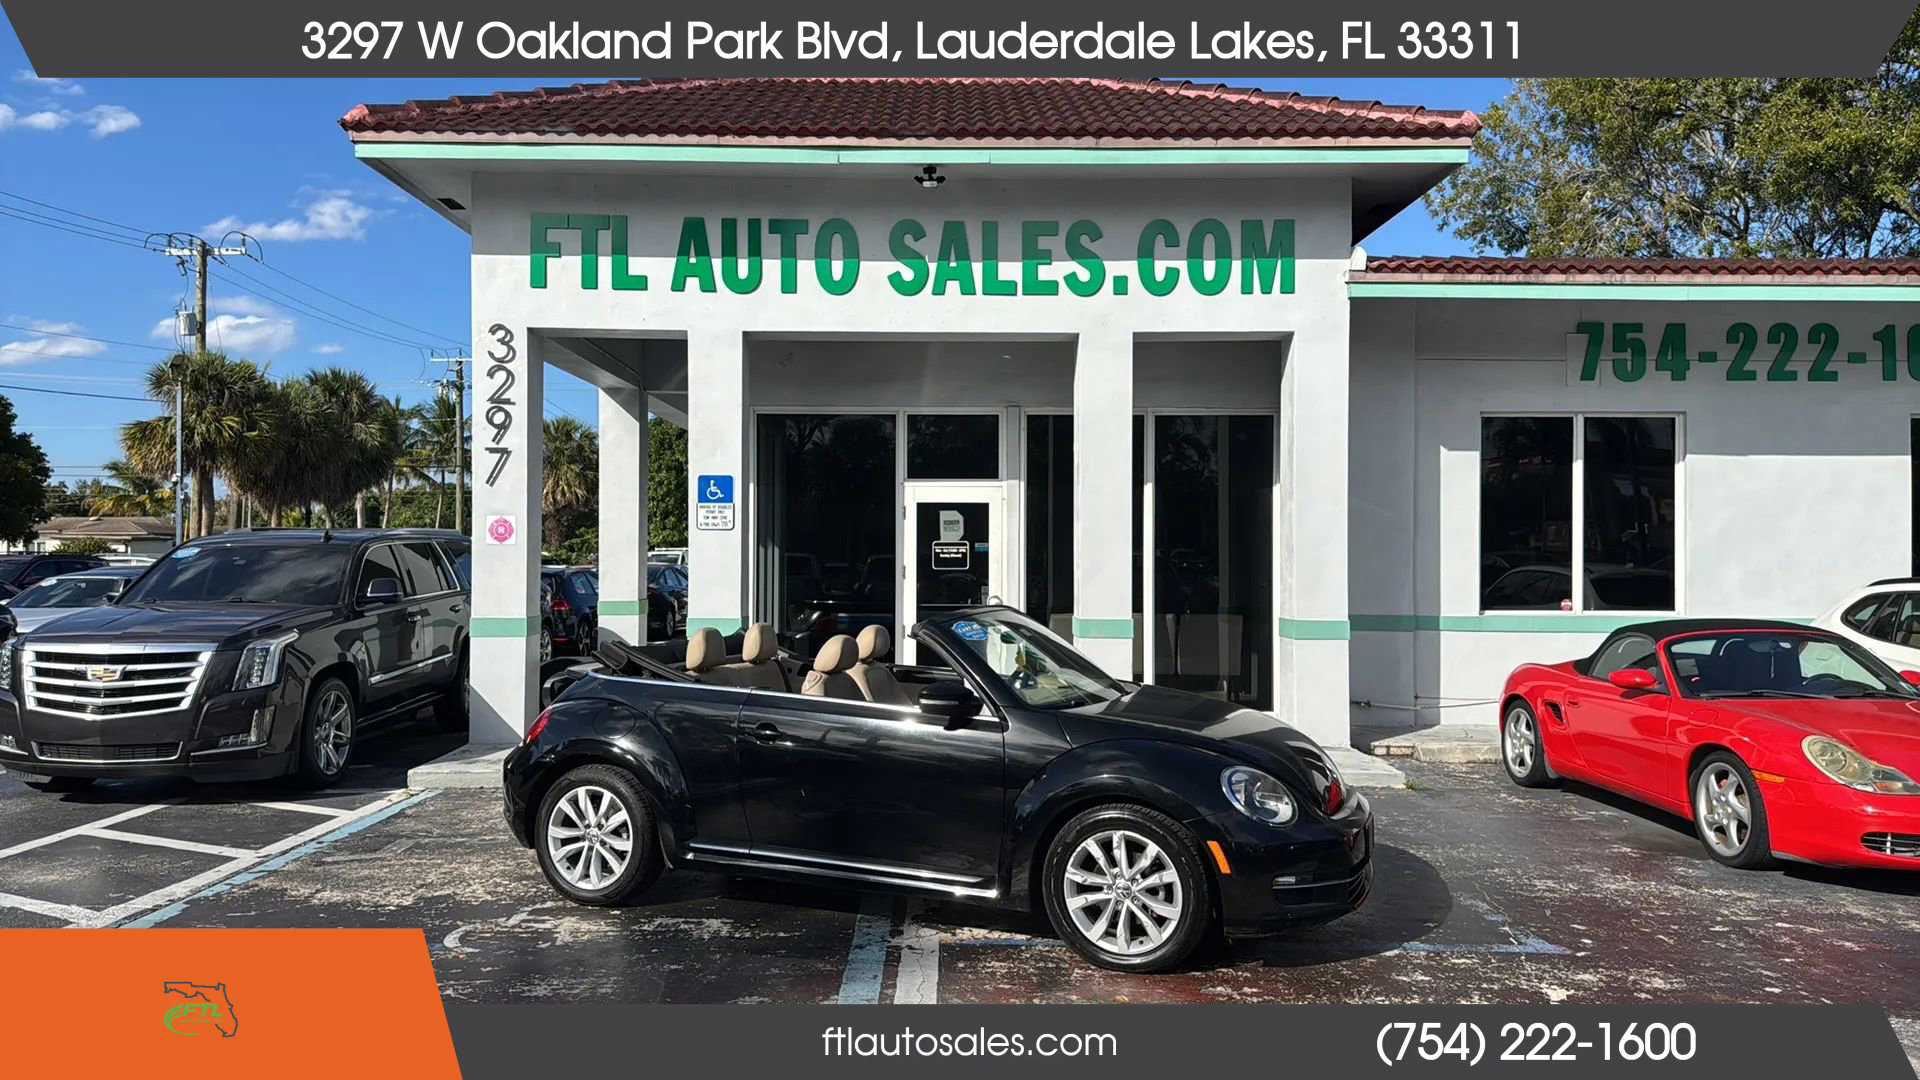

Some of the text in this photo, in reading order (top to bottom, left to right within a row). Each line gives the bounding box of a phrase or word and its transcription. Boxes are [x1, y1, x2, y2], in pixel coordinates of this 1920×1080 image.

[529, 212, 1297, 297] FTL AUTO SALES.COM
[484, 322, 517, 488] 3297
